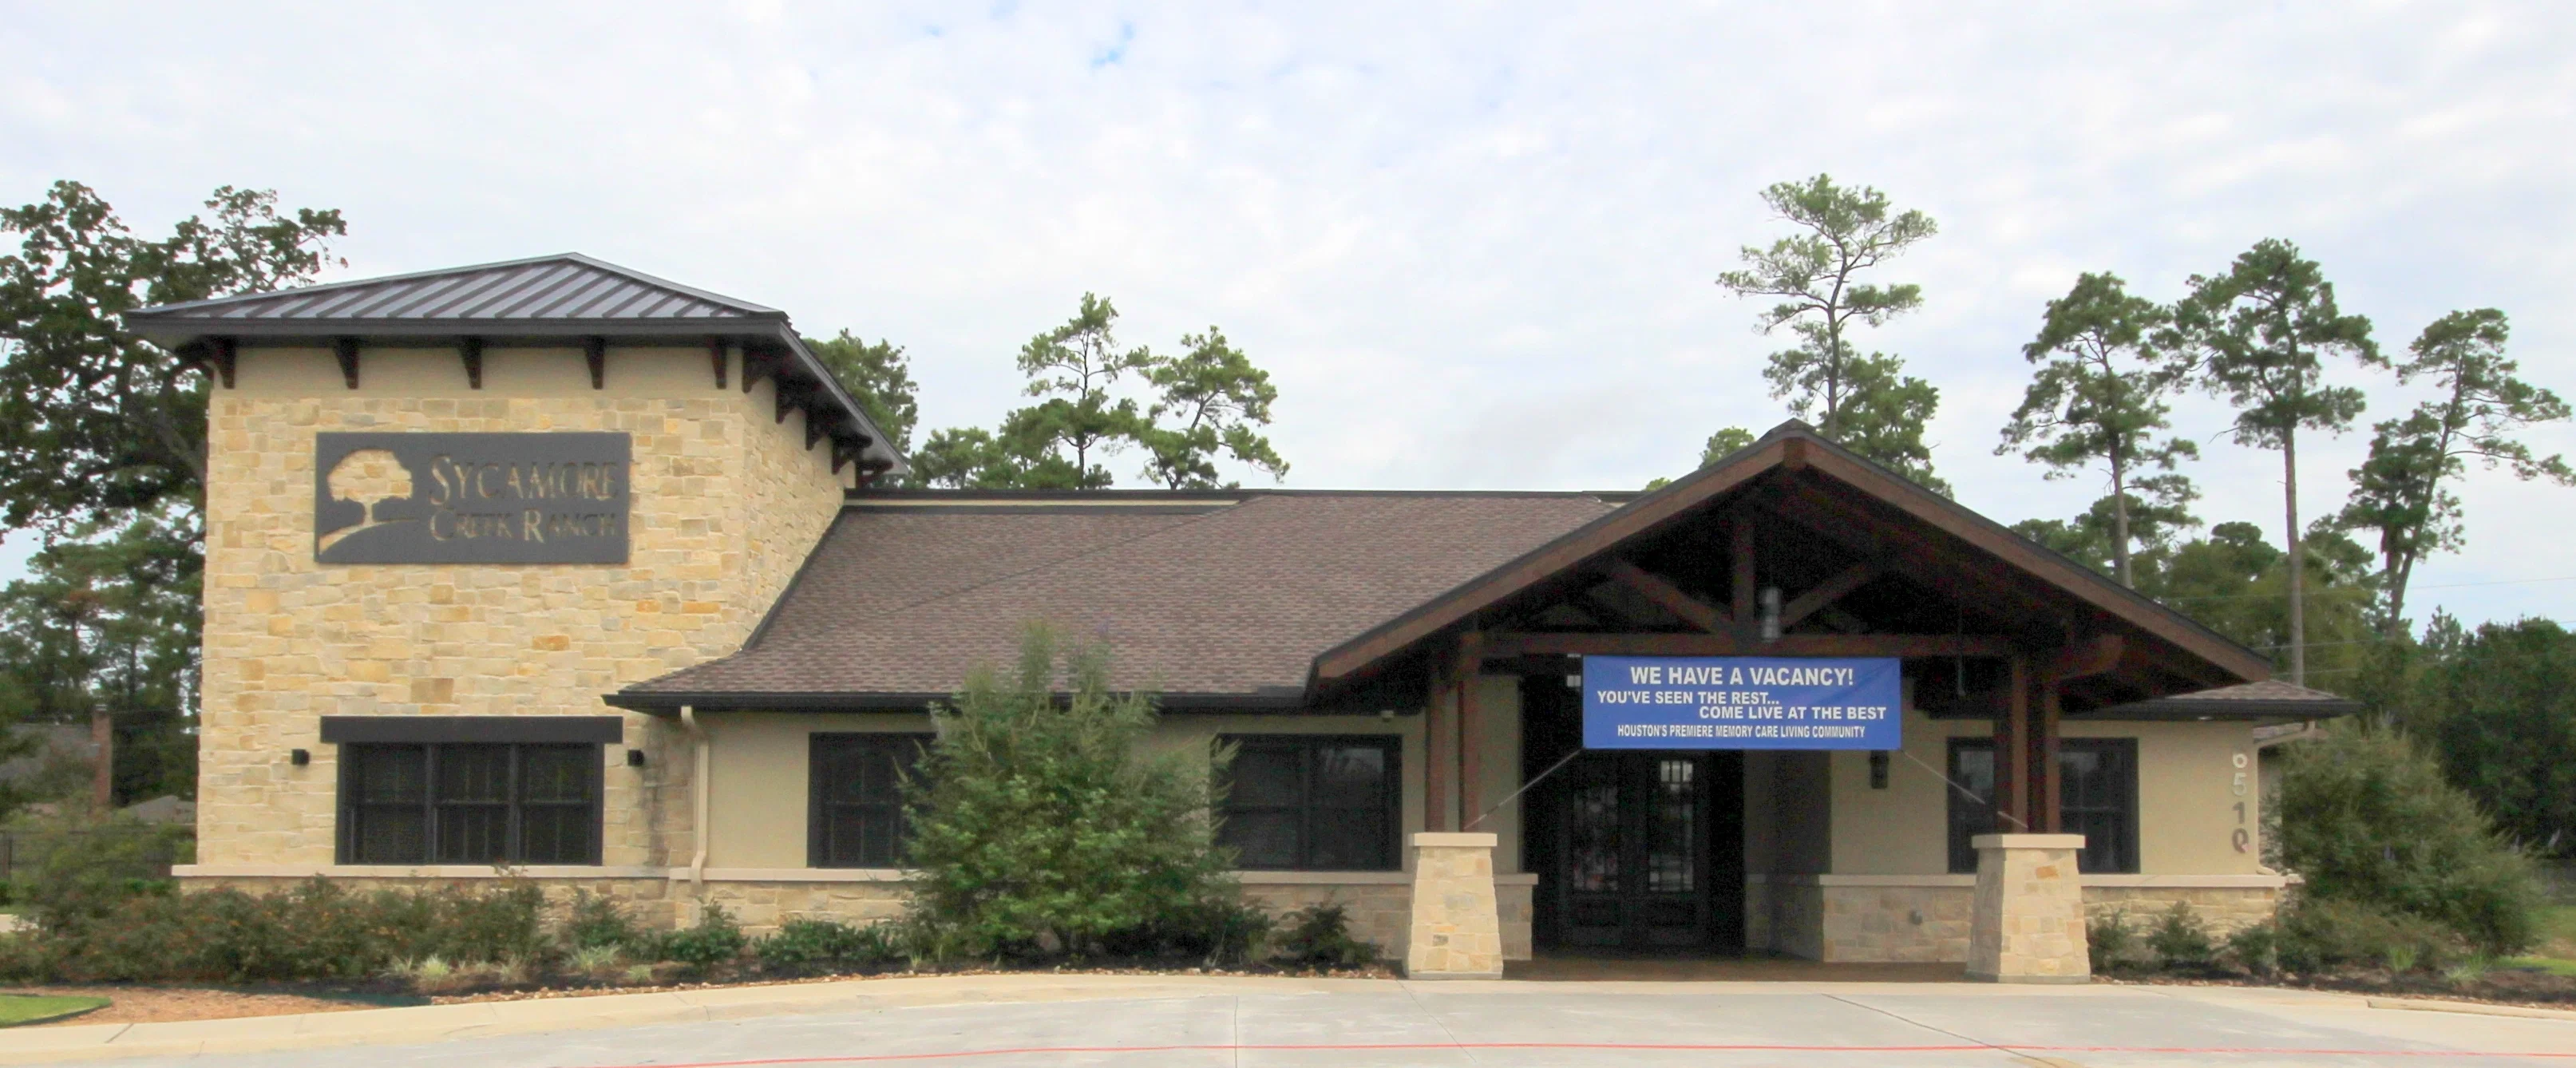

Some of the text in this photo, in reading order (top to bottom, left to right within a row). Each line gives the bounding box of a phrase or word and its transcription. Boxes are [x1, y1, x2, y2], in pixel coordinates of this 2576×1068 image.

[428, 454, 618, 505] SYCAMORE
[429, 508, 616, 544] CREEK RANCH
[1630, 667, 1854, 686] WE HAVE A VACANCY!
[1597, 690, 1779, 705] YOU'VE SEEN THE REST...
[1700, 706, 1886, 719] COME LIVE AT THE BEST
[1618, 725, 1865, 738] HOUSTON'S PREMIERE MEMORY CARE LIVING COMMUNITY
